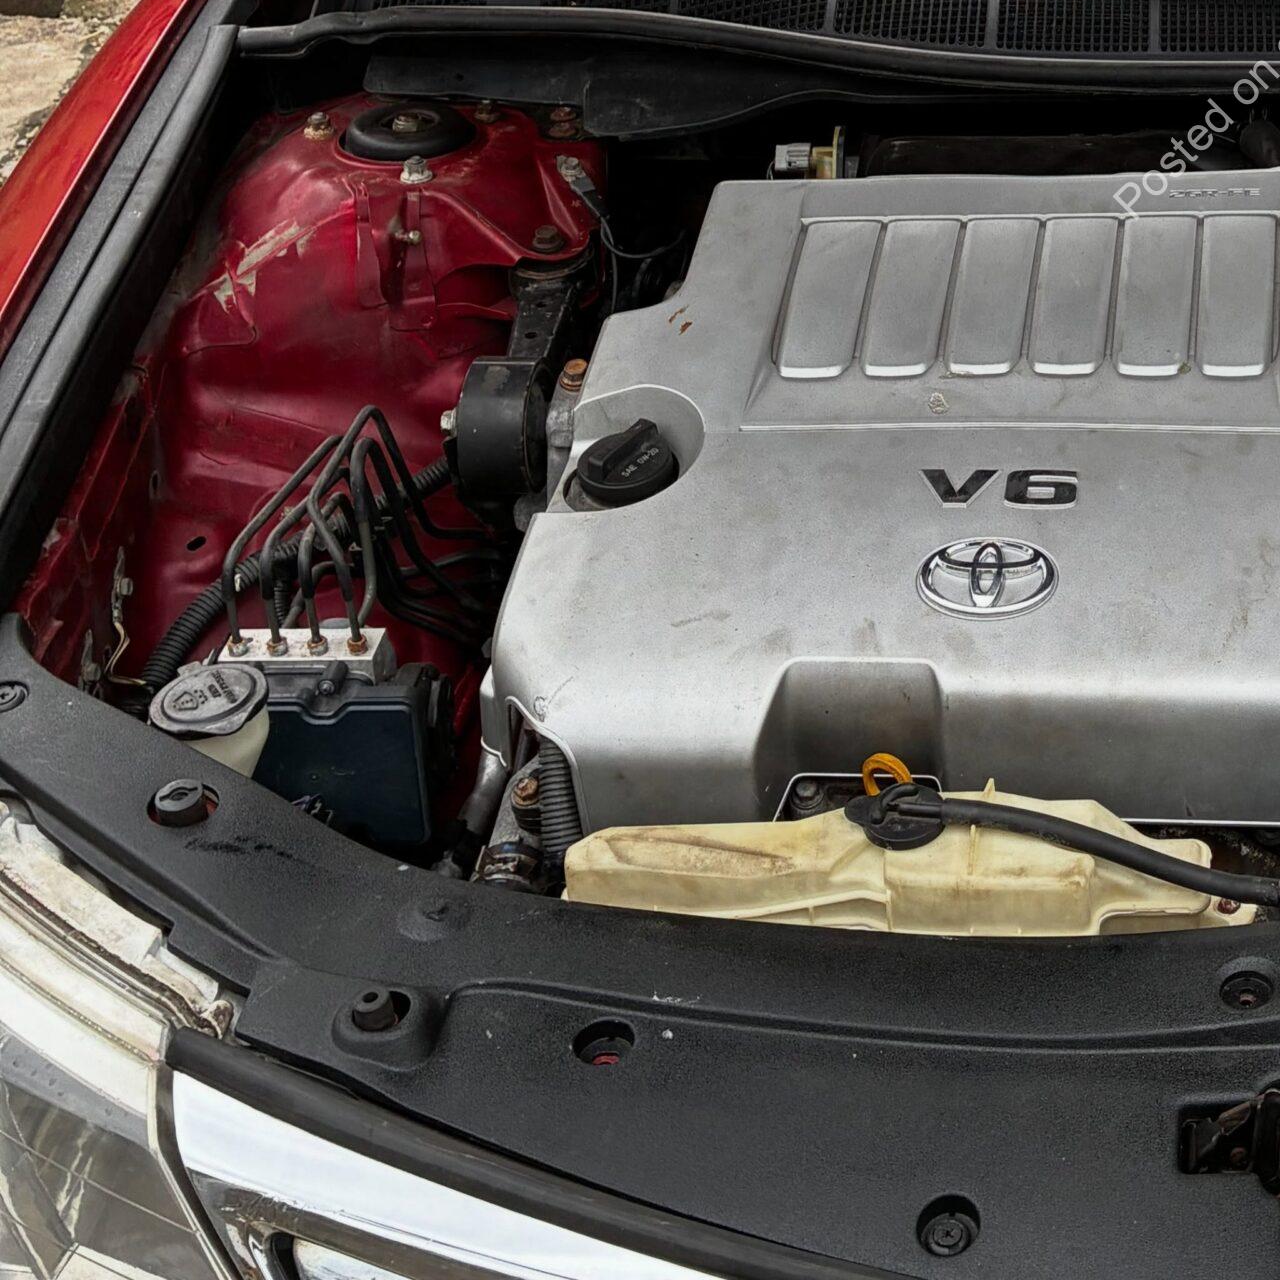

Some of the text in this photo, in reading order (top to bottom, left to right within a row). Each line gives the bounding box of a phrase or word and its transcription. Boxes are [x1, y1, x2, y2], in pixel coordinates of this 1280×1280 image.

[1168, 187, 1261, 199] 2GR-FE
[620, 464, 638, 477] SAE
[919, 468, 1079, 510] V6
